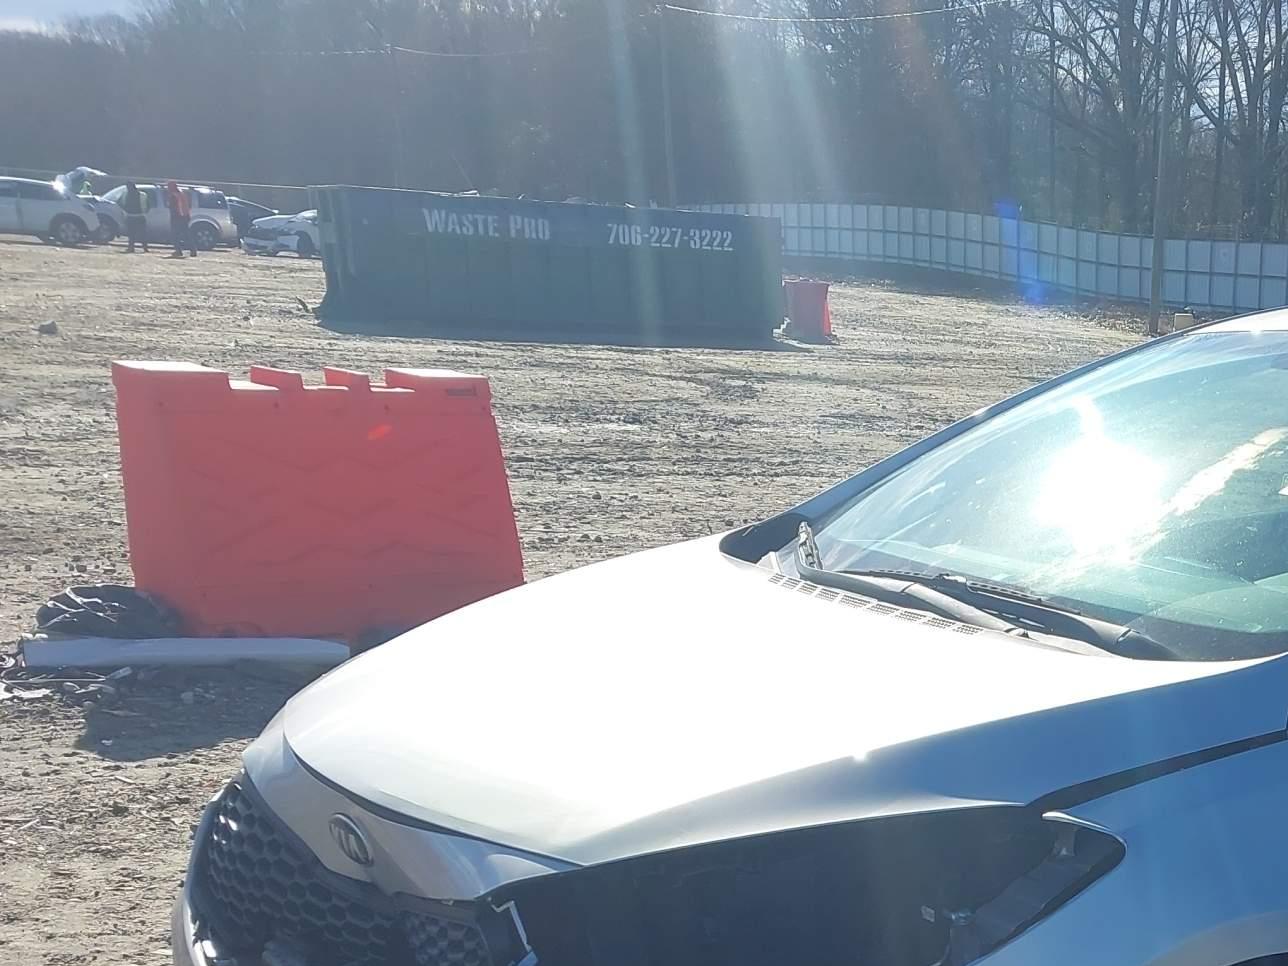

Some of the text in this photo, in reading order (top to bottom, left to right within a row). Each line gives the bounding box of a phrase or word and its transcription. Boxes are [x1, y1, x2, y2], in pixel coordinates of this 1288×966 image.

[422, 207, 551, 241] WASTE PRO
[606, 223, 734, 251] 706-227-3222
